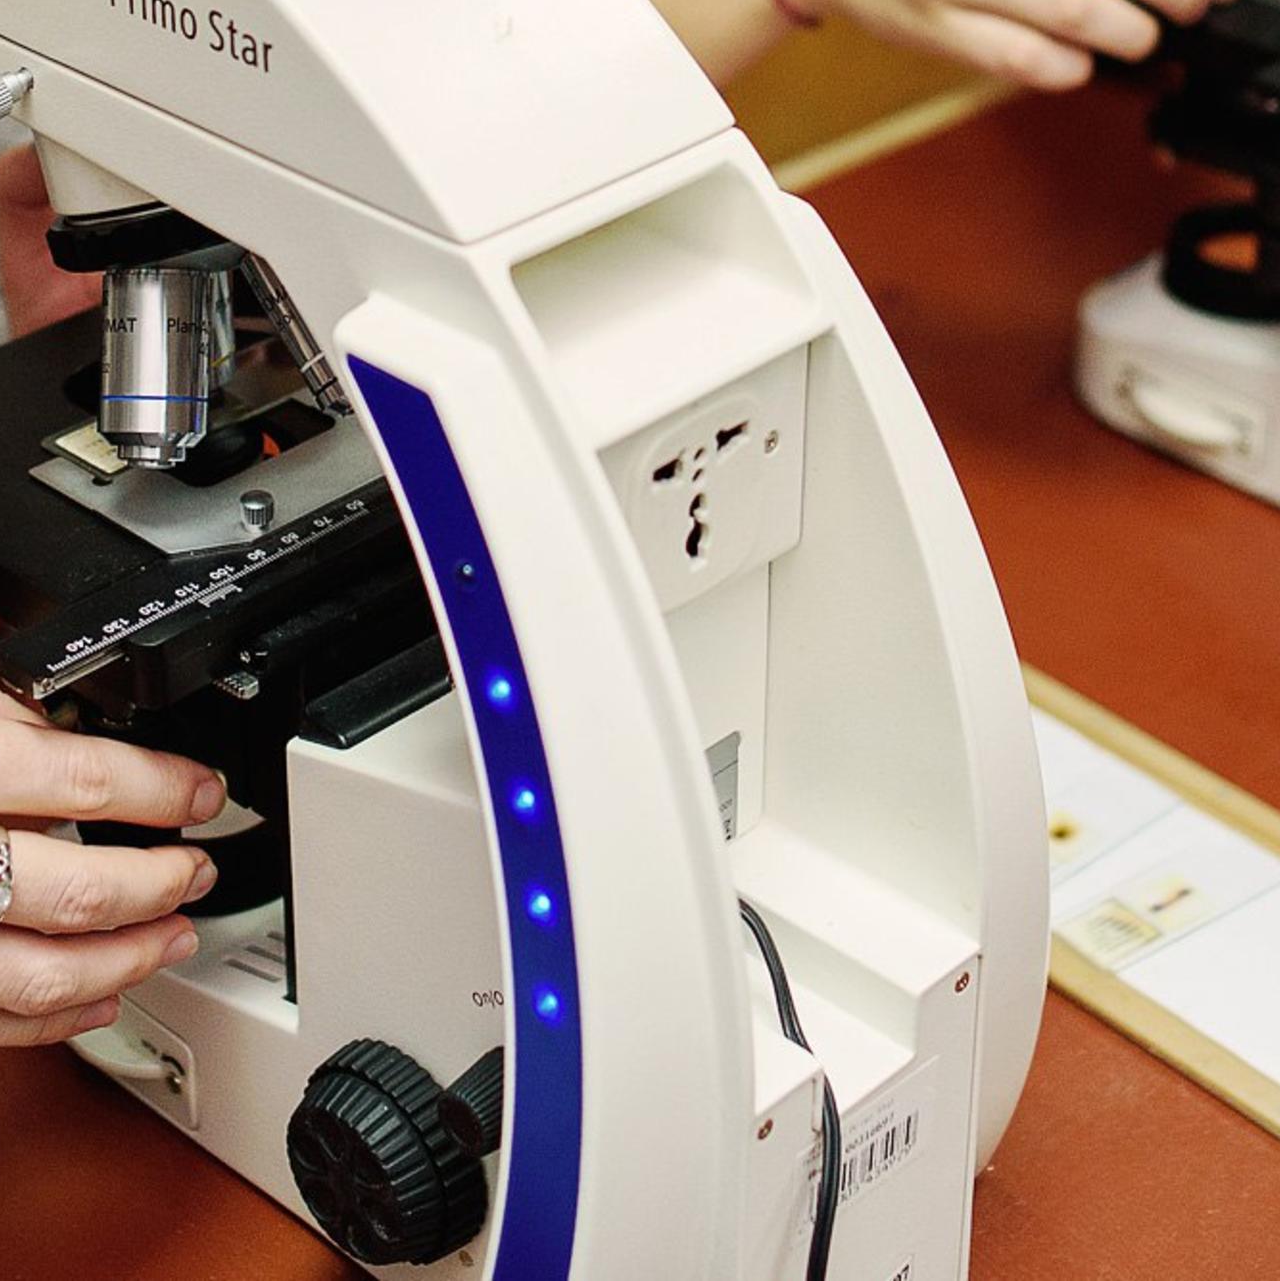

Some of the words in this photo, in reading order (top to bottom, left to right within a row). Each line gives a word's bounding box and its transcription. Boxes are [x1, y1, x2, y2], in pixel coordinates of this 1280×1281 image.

[208, 10, 274, 73] Star
[313, 516, 333, 528] 70
[246, 548, 268, 561] 90
[208, 564, 236, 580] 100
[174, 581, 200, 598] 110
[138, 599, 165, 616] 120
[102, 617, 130, 634] 130
[65, 635, 94, 653] 140
